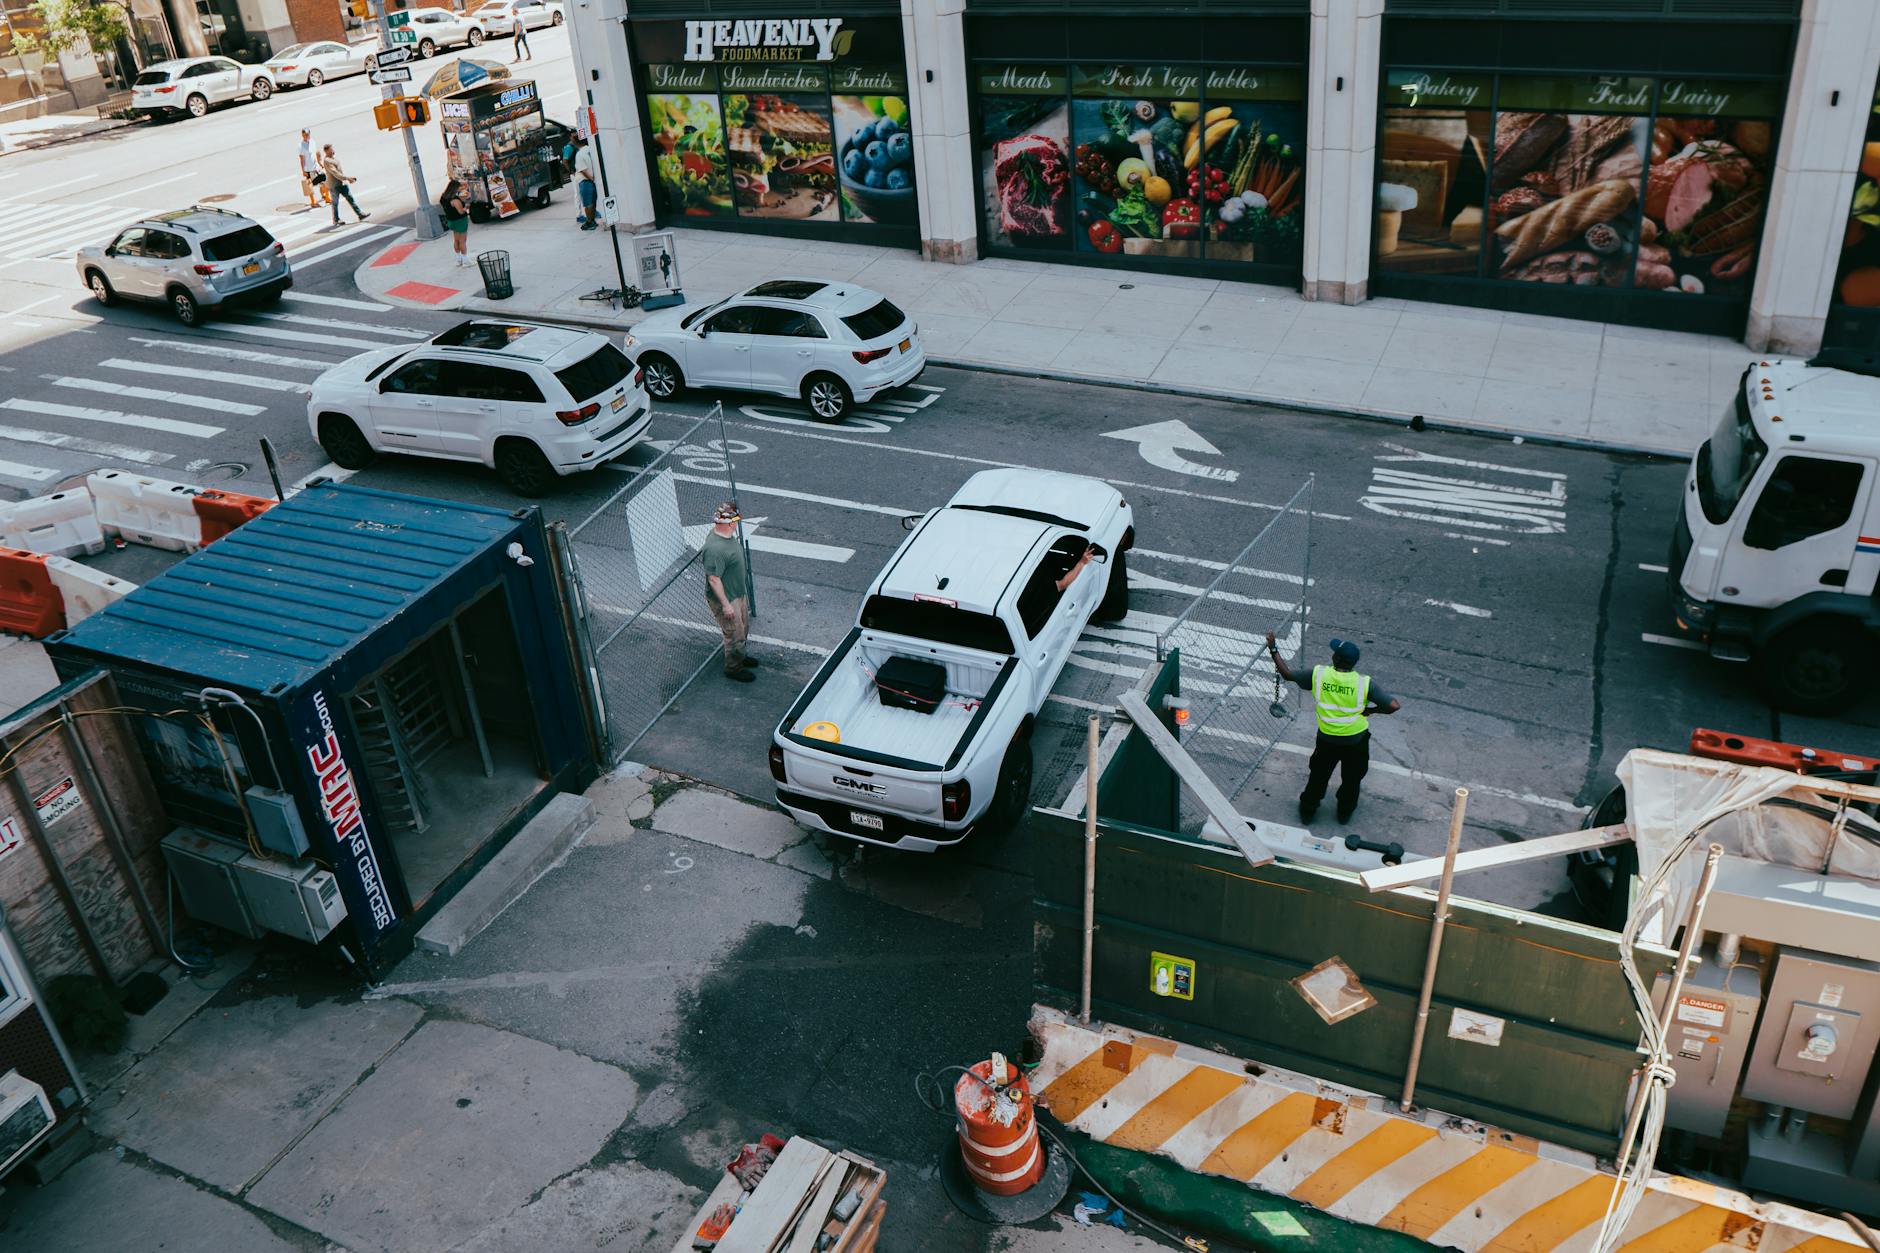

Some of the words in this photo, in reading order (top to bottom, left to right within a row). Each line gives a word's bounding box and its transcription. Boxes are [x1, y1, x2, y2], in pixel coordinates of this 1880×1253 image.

[684, 18, 843, 61] HEAVENLY
[722, 48, 803, 61] FOODMARKET
[655, 65, 705, 87] Salad
[723, 65, 822, 89] Sandwiches
[842, 67, 893, 89] Fruits
[990, 66, 1052, 89] Meats
[1101, 64, 1153, 88] Fresh
[1406, 73, 1480, 105] Bakery
[1588, 79, 1649, 106] Fresh
[1661, 80, 1731, 115] Dairy
[1322, 682, 1355, 696] SECURITY
[832, 775, 887, 795] GMC
[41, 796, 80, 825] SMOKING
[50, 796, 64, 810] NO
[348, 826, 366, 858] BY
[358, 855, 390, 931] SECURED
[1689, 999, 1725, 1011] DANGER
